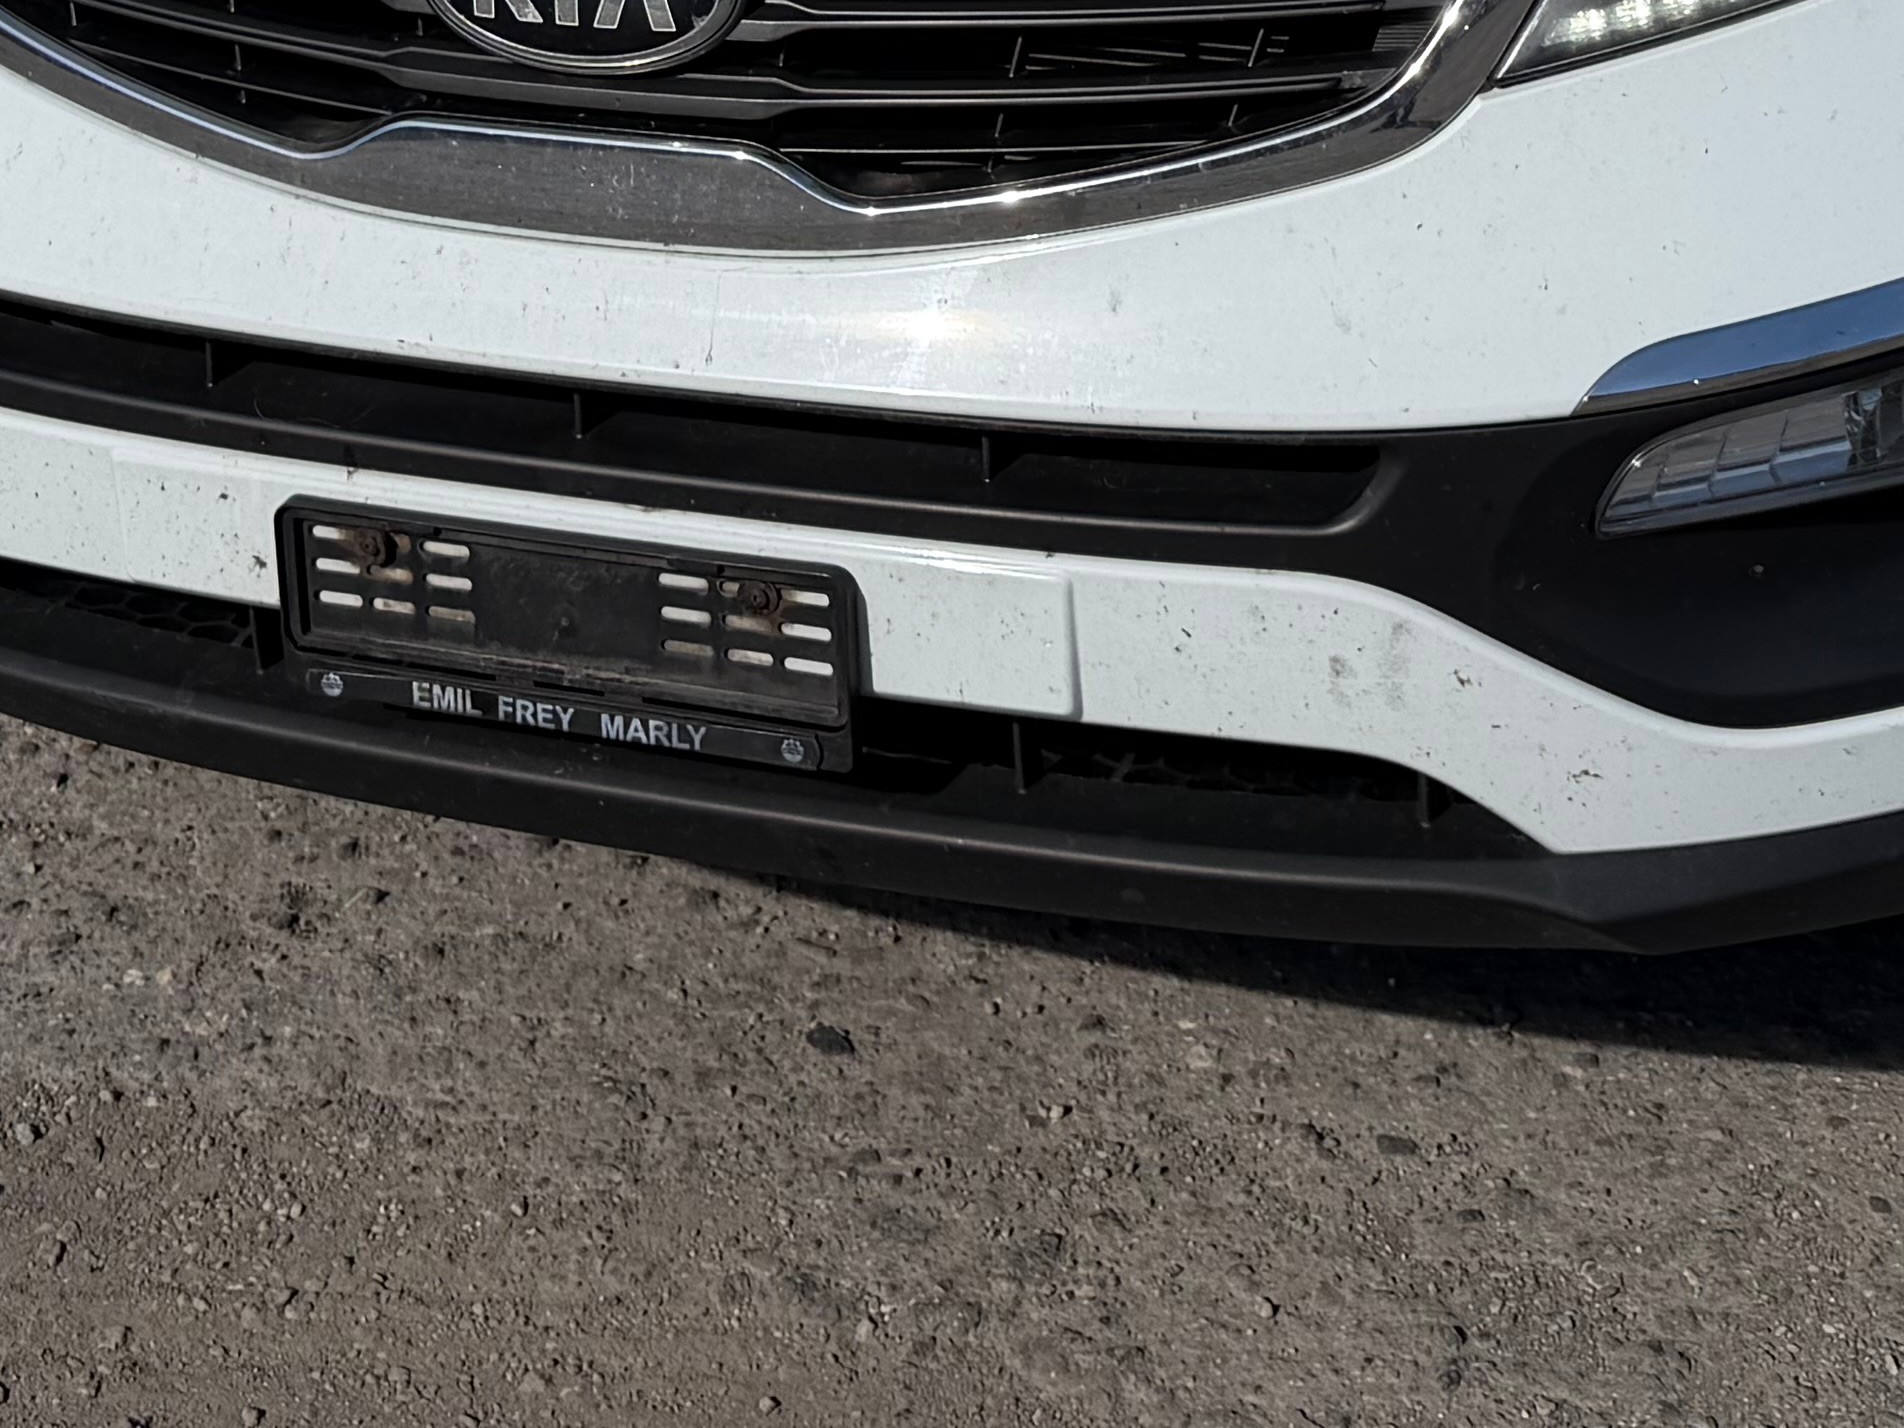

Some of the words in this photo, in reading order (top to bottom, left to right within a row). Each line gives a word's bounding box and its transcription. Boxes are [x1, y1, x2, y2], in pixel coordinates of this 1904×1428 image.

[412, 680, 483, 718] EMIL
[497, 694, 575, 732] FREY
[599, 713, 707, 752] MARLY
